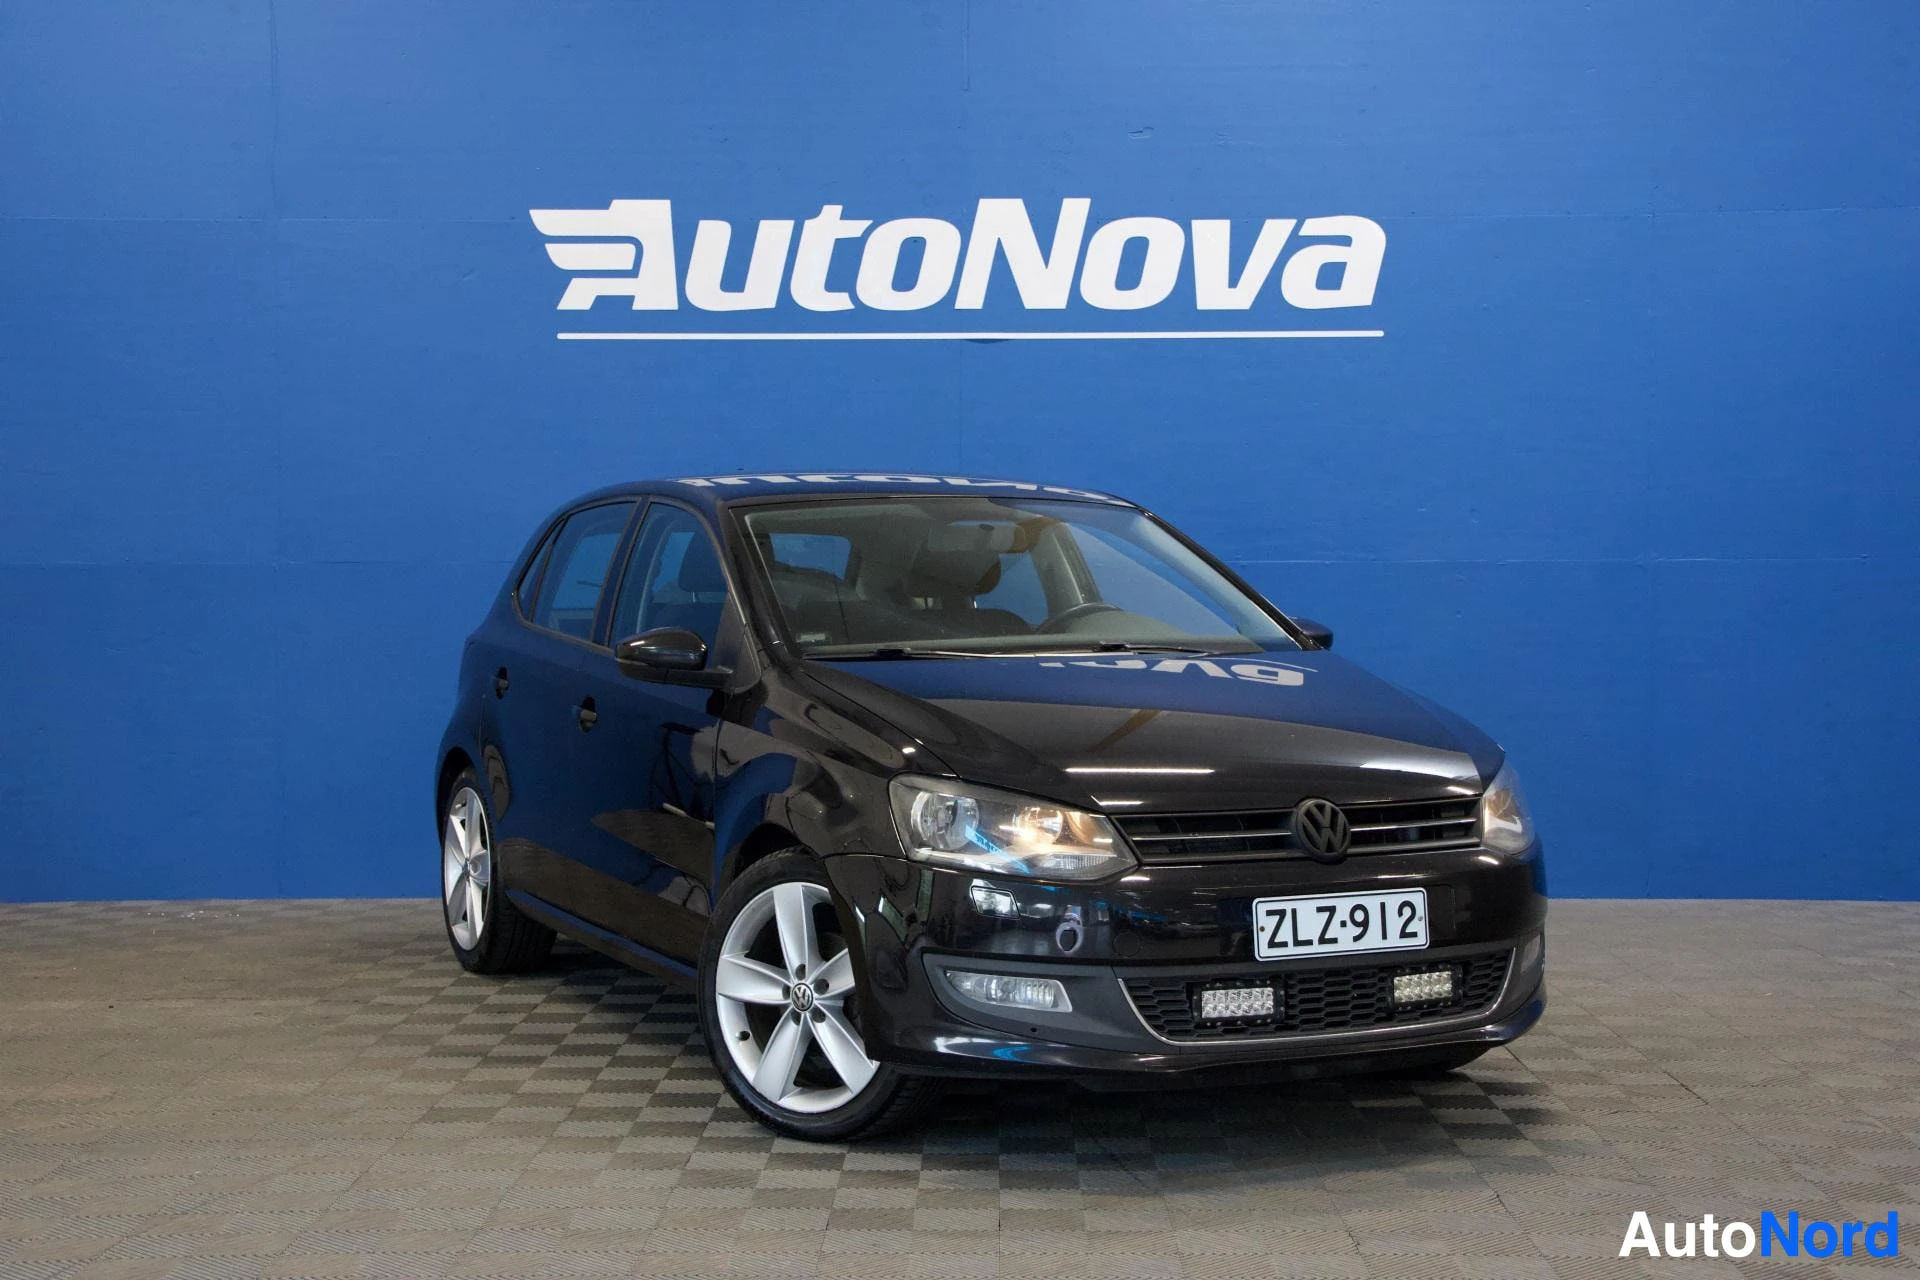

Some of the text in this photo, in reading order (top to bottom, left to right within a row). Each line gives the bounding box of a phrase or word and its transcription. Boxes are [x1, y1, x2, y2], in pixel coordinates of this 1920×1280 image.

[529, 197, 1387, 312] AutoNova
[1297, 799, 1350, 857] VW
[1265, 900, 1419, 949] ZLZ-912
